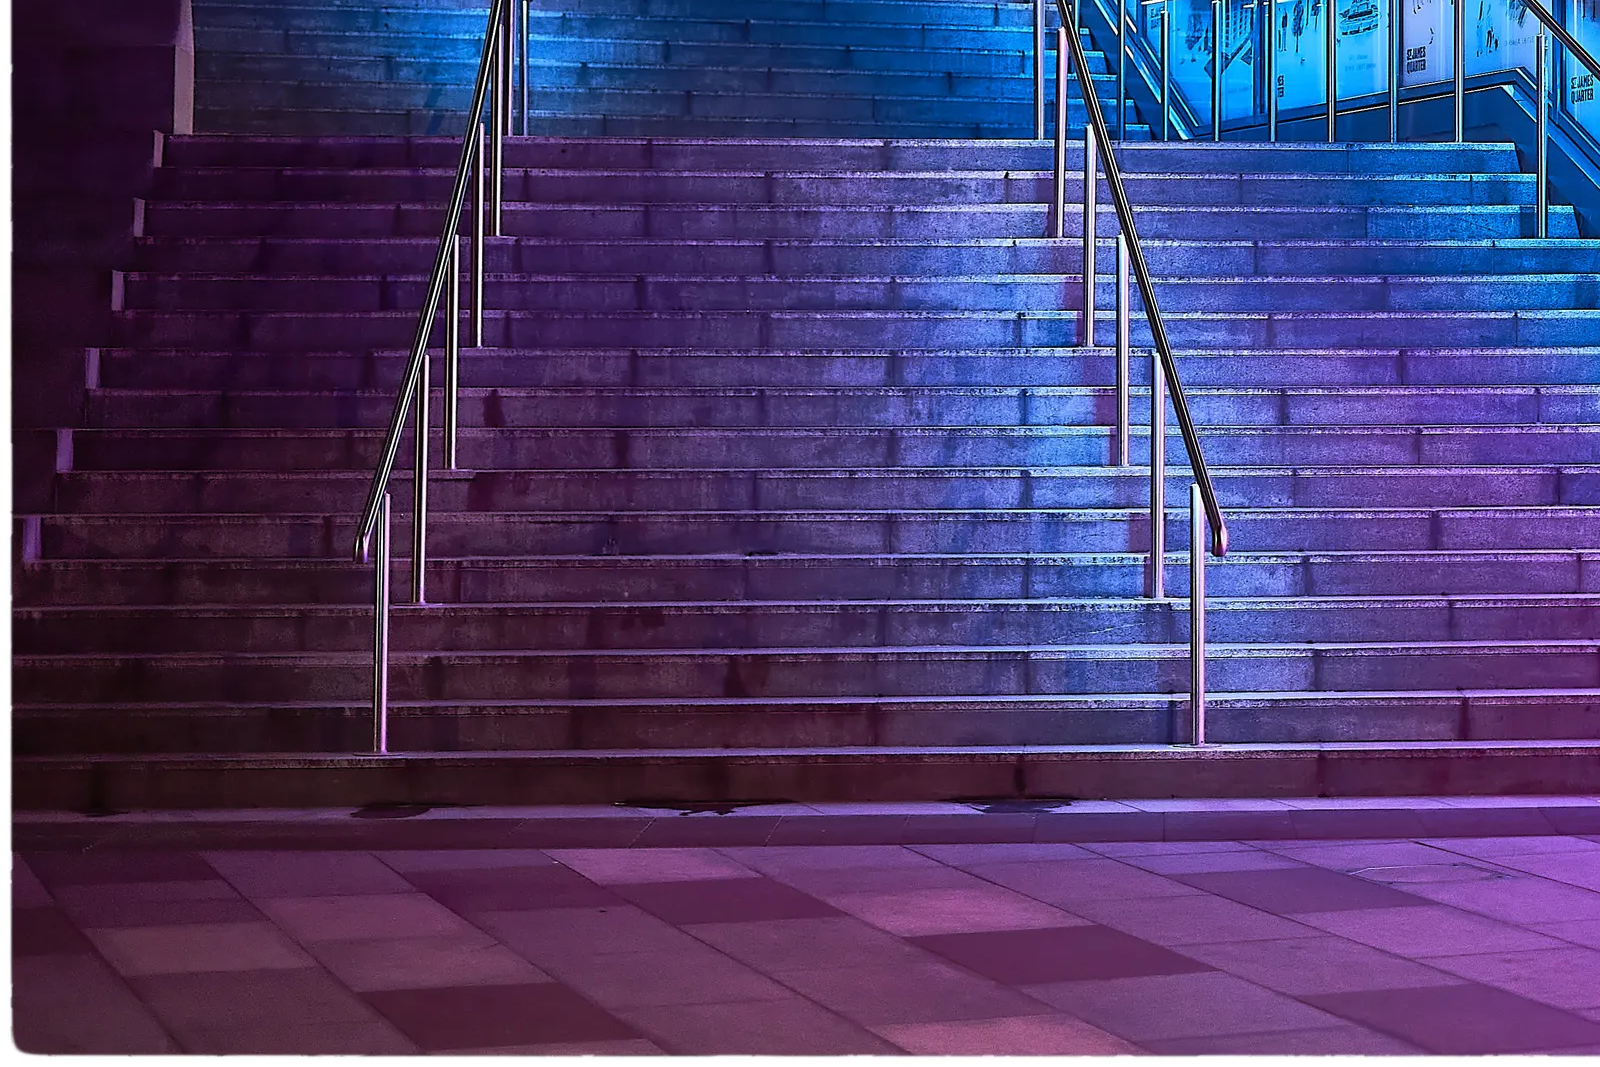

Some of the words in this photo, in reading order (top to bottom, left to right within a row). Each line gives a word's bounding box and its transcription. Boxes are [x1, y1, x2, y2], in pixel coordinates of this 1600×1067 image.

[1412, 45, 1426, 59] JAMES
[1406, 59, 1426, 74] QUARTER
[1577, 74, 1594, 88] JAMES
[1570, 88, 1594, 104] QUARTER
